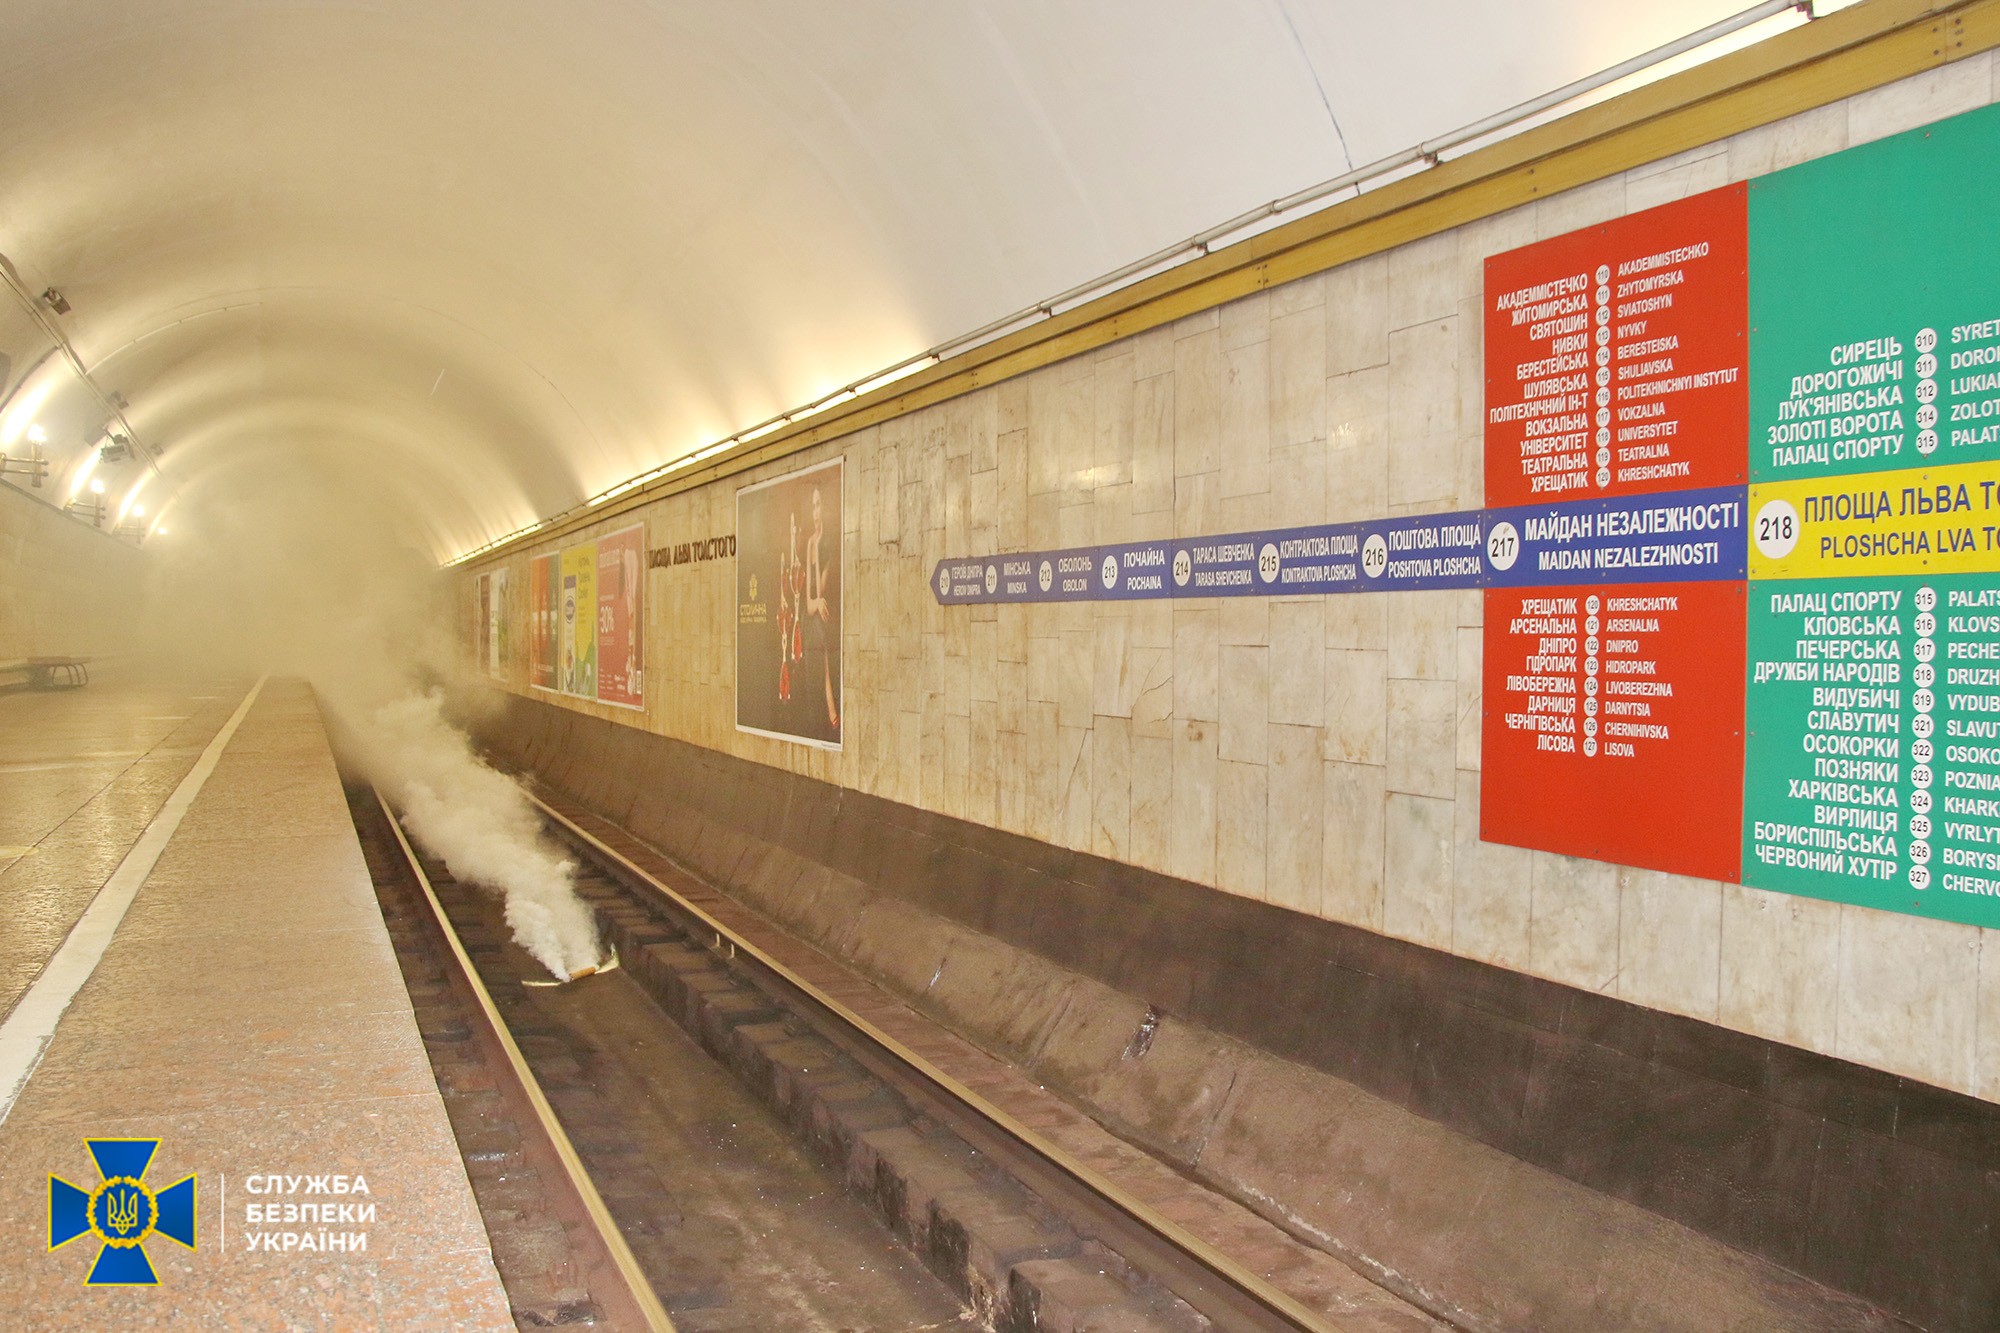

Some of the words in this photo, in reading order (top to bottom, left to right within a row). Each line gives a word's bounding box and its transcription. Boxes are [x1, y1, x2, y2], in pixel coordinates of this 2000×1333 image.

[1618, 242, 1709, 277] AKADEMMISTECHKO
[1597, 269, 1608, 280] 110
[1497, 274, 1588, 311] АКАДЕММІСТЕЧКО
[1617, 270, 1683, 298] ZHYTOMYRSKA
[1597, 289, 1608, 300] 111
[1512, 294, 1588, 326] ЖИТОМИРСЬКА
[1597, 309, 1608, 320] 112
[1617, 294, 1672, 318] SVIATOSHYN
[1530, 313, 1588, 341] СВЯТОШИН
[1618, 321, 1647, 339] NYVKY
[1552, 333, 1588, 355] НИВКИ
[1597, 331, 1608, 342] 113
[1916, 334, 1933, 346] 310
[1597, 350, 1608, 362] 114
[1618, 336, 1678, 359] BERESTEISKA
[1830, 336, 1902, 366] СИРЕЦЬ
[1517, 352, 1588, 380] БЕРЕСТЕЙСЬКА
[1618, 358, 1673, 380] SHULIAVSKA
[1916, 360, 1933, 372] 311
[1597, 370, 1608, 382] 115
[1618, 375, 1692, 401] POLITEKHNICHNYI
[1694, 368, 1738, 388] INSTYTUT
[1790, 360, 1902, 399] ДОРОГОЖИЧІ
[1524, 373, 1588, 399] ШУЛЯВСЬКА
[1916, 385, 1933, 397] 312
[1597, 391, 1608, 402] 116
[1778, 385, 1903, 421] ЛУК'ЯНІВСЬКА
[1490, 394, 1566, 423] ПОЛІТЕХНІЧНИЙ
[1569, 393, 1588, 410] ІН-Т
[1597, 411, 1608, 422] 117
[1618, 402, 1665, 421] VOKZALNA
[1916, 410, 1934, 423] 314
[1526, 413, 1588, 436] ВОКЗАЛЬНА
[1618, 421, 1678, 442] UNIVERSYTET
[1768, 420, 1826, 444] ЗОЛОТІ
[1830, 410, 1903, 438] ВОРОТА
[1520, 432, 1588, 456] УНІВЕРСИТЕТ
[1597, 431, 1608, 442] 118
[1917, 435, 1934, 448] 315
[1597, 451, 1608, 462] 119
[1618, 443, 1669, 462] TEATRALNA
[1773, 445, 1829, 466] ПАЛАЦ
[1833, 434, 1903, 461] СПОРТУ
[1522, 452, 1588, 475] ТЕАТРАЛЬНА
[1618, 461, 1690, 482] KHRESHCHATYK
[1531, 471, 1588, 493] ХРЕЩАТИК
[1597, 471, 1608, 483] 120
[1804, 491, 1892, 523] ПЛОЩА
[1900, 484, 1971, 516] ЛЬВА
[1525, 511, 1591, 542] МАЙДАН
[1598, 502, 1739, 536] НЕЗАЛЕЖНОСТІ
[1760, 516, 1792, 541] 218
[1389, 531, 1438, 551] ПОШТОВА
[1440, 524, 1481, 549] ПЛОЩА
[1821, 531, 1930, 558] PLOSHCHA
[1937, 528, 1976, 553] LVA
[692, 534, 736, 562] ТОЛСТОГО
[1193, 547, 1217, 564] ТАРАСА
[1218, 543, 1254, 562] ШЕВЧЕНКА
[1280, 538, 1328, 558] КОНТРАКТОВА
[1330, 535, 1358, 557] ПЛОЩА
[1492, 536, 1514, 558] 217
[1059, 557, 1092, 572] ОБОЛОНЬ
[1124, 548, 1165, 568] ПОЧАЙНА
[1262, 556, 1276, 572] 215
[1365, 548, 1383, 565] 216
[1539, 548, 1591, 570] MAIDAN
[1596, 542, 1718, 568] NEZALEZHNOSTI
[1004, 561, 1031, 576] МІНСЬКА
[1041, 569, 1050, 582] 212
[1104, 565, 1115, 578] 213
[1176, 562, 1188, 576] 214
[1282, 567, 1323, 583] KONTRAKTOVA
[1323, 564, 1356, 581] PLOSHCHA
[1388, 560, 1433, 578] POSHTOVA
[1433, 557, 1481, 576] PLOSHCHA
[987, 575, 995, 586] 211
[1007, 582, 1027, 594] MINSKA
[1063, 578, 1087, 592] OBOLON
[1127, 576, 1162, 590] POCHAINA
[1195, 573, 1215, 586] TARASA
[1522, 598, 1577, 616] ХРЕЩАТИК
[1587, 601, 1598, 610] 120
[1607, 597, 1677, 611] KHRESHCHATYK
[1771, 594, 1827, 615] ПАЛАЦ
[1831, 591, 1901, 612] СПОРТУ
[1916, 593, 1932, 605] 315
[1510, 618, 1576, 634] АРСЕНАЛЬНА
[1587, 621, 1598, 630] 121
[1606, 619, 1659, 632] ARSENALNA
[1804, 616, 1900, 635] КЛОВСЬКА
[1915, 619, 1932, 631] 316
[1948, 616, 2000, 633] KLOVS
[1538, 638, 1576, 656] ДНІПРО
[1587, 641, 1598, 650] 122
[1606, 640, 1638, 653] DNIPRO
[1796, 640, 1900, 659] ПЕЧЕРСЬКА
[1915, 644, 1932, 656] 317
[1948, 642, 2000, 659] PECHE
[1526, 656, 1576, 673] ГІДРОПАРК
[1586, 662, 1597, 670] 123
[1606, 661, 1656, 674] HIDROPARK
[1754, 662, 1819, 683] ДРУЖБИ
[1823, 663, 1900, 686] НАРОДІВ
[1915, 669, 1931, 681] 318
[1947, 668, 2000, 685] DRUZH
[1506, 676, 1576, 693] ЛІВОБЕРЕЖНА
[1586, 682, 1597, 691] 124
[1606, 681, 1672, 696] LIVOBEREZHNA
[1528, 696, 1576, 714] ДАРНИЦЯ
[1586, 702, 1597, 711] 125
[1813, 687, 1899, 710] ВИДУБИЧІ
[1914, 695, 1931, 706] 319
[1948, 694, 2000, 712] VYDUB
[1605, 702, 1650, 716] DARNYTSIA
[1505, 714, 1575, 733] ЧЕРНІГІВСЬКА
[1585, 722, 1596, 731] 126
[1605, 722, 1669, 739] CHERNIHIVSKA
[1807, 711, 1899, 733] СЛАВУТИЧ
[1914, 720, 1930, 731] 321
[1537, 734, 1575, 752] ЛІСОВА
[1585, 742, 1596, 751] 127
[1605, 742, 1634, 757] LISOVA
[1803, 734, 1899, 758] ОСОКОРКИ
[1913, 745, 1930, 756] 322
[1815, 758, 1898, 782] ПОЗНЯКИ
[1913, 770, 1929, 781] 323
[1945, 771, 2000, 791] POZNIA
[1788, 779, 1899, 807] ХАРКІВСЬКА
[1912, 796, 1929, 807] 324
[1945, 796, 2000, 817] KHARK
[1814, 805, 1897, 834] ВИРЛИЦЯ
[1911, 821, 1928, 832] 325
[1754, 821, 1898, 857] БОРИСПІЛЬСЬКА
[1910, 846, 1928, 857] 326
[1755, 844, 1844, 874] ЧЕРВОНИЙ
[1848, 858, 1898, 880] ХУТІР
[1909, 871, 1927, 882] 327
